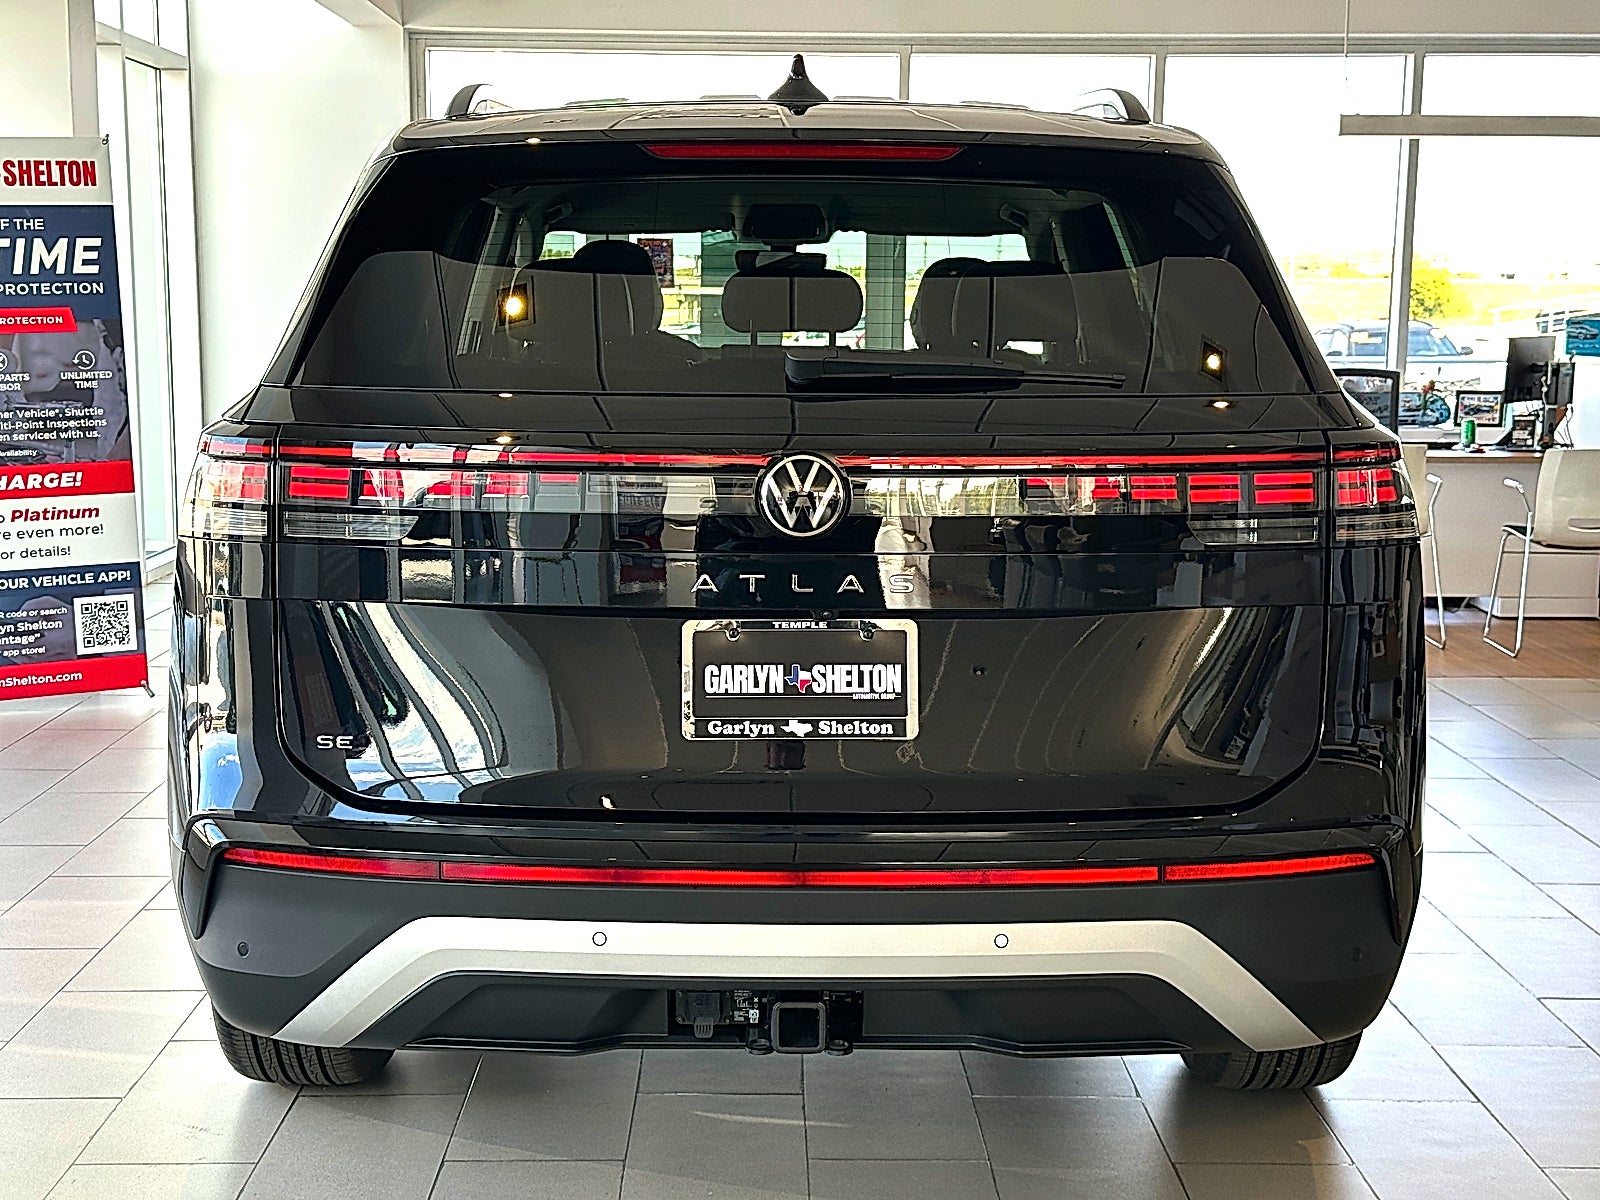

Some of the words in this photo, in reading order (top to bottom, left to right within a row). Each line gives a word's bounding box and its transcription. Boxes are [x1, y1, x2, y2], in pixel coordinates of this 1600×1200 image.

[2, 159, 97, 187] SHELTON
[13, 218, 45, 231] THE
[61, 371, 112, 379] UNLIMITED
[65, 407, 104, 416] Shuttle
[47, 418, 107, 430] Inspections
[13, 431, 57, 440] serviced
[60, 430, 83, 439] with
[86, 430, 101, 438] us.
[11, 507, 100, 522] Platinum
[17, 528, 54, 539] even
[60, 524, 104, 536] more!
[20, 546, 71, 559] details!
[32, 572, 94, 587] VEHICLE
[98, 570, 131, 583] APP!
[690, 574, 915, 594] ATLAS
[6, 610, 27, 619] code
[40, 607, 67, 616] search
[17, 620, 62, 632] Shelton
[772, 621, 828, 629] TEMPLE
[3, 650, 19, 658] app
[22, 646, 46, 655] store!
[704, 664, 784, 694] GARLYN
[811, 664, 902, 694] SHELTON
[707, 721, 775, 738] Garlyn
[817, 721, 893, 735] Shelton
[316, 735, 354, 749] SE
